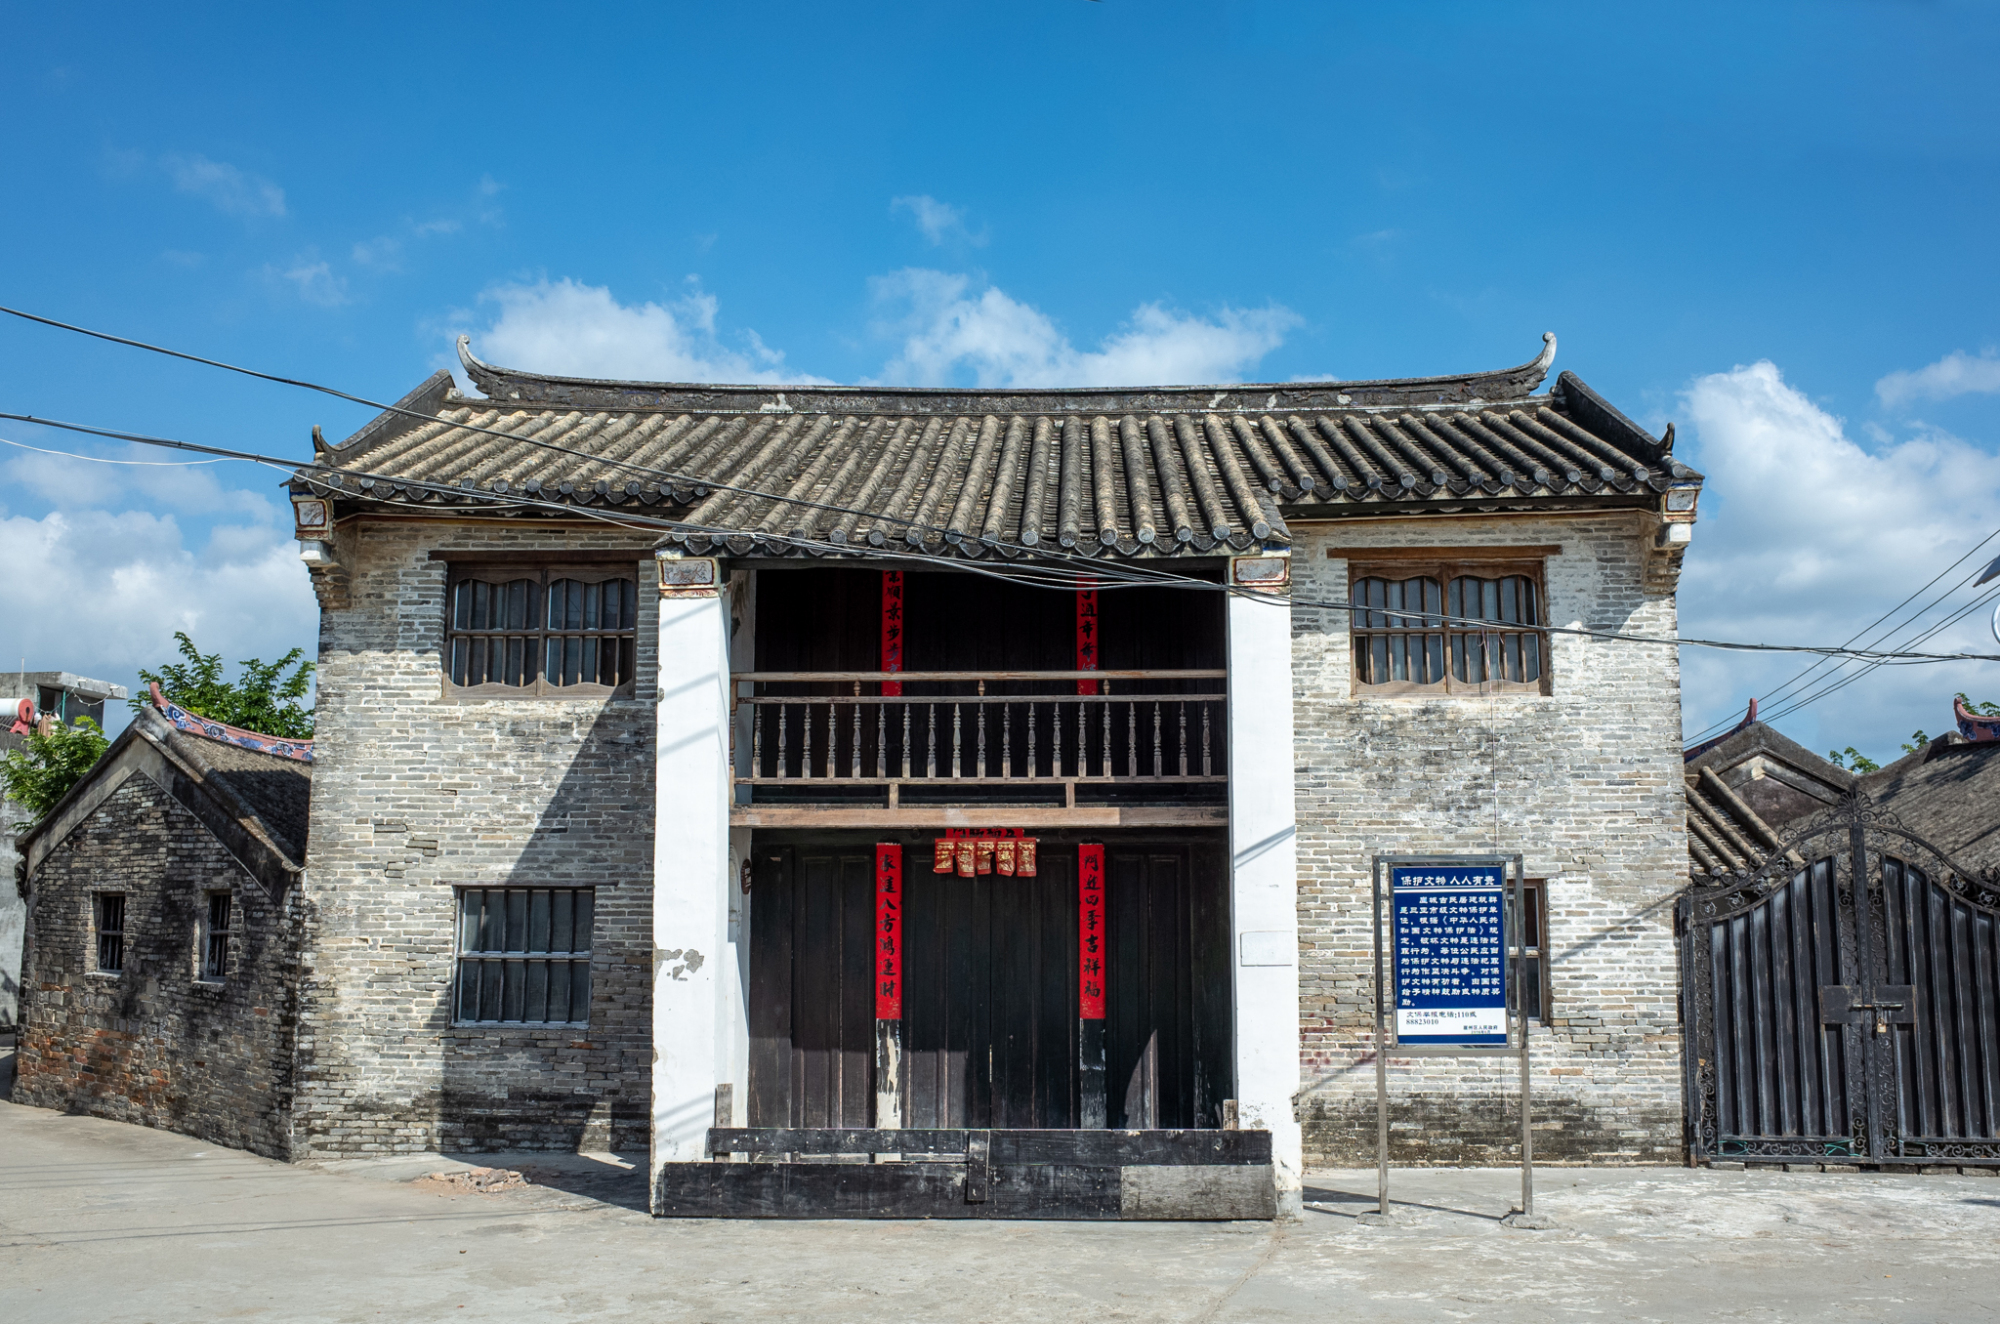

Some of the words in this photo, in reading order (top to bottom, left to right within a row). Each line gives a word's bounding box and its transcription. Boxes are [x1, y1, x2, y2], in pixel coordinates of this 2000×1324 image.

[1401, 875, 1446, 886] 保护文物
[1450, 875, 1495, 885] 人人有责
[1083, 854, 1101, 998] 門迎四季吉祥福
